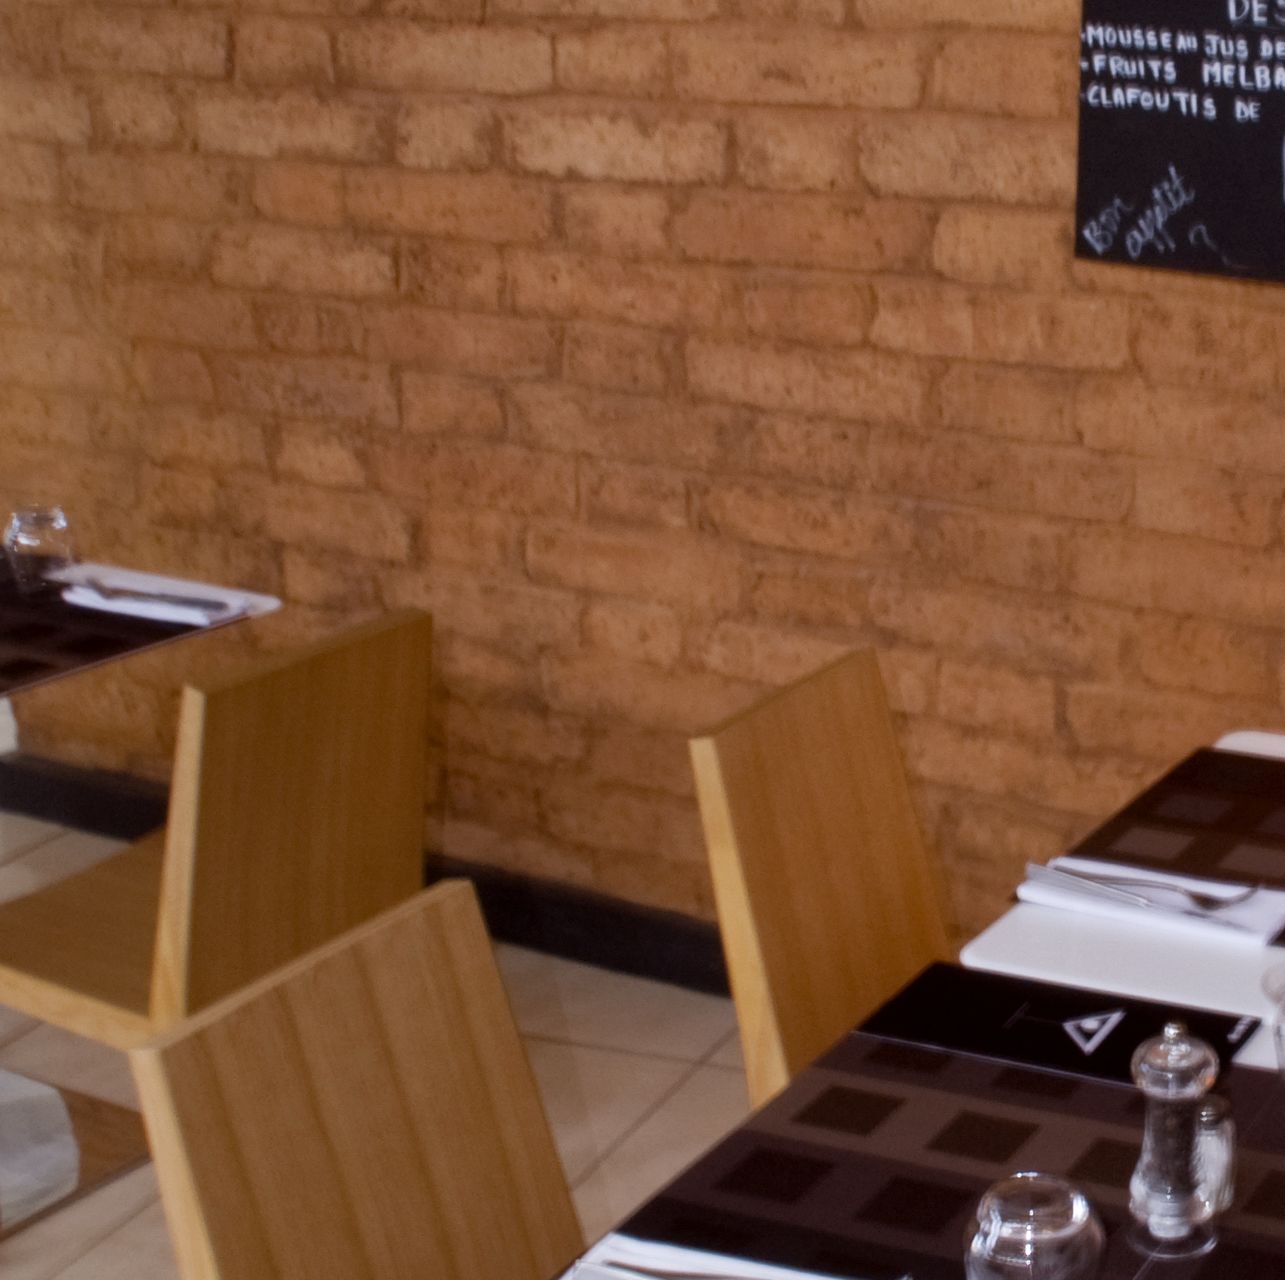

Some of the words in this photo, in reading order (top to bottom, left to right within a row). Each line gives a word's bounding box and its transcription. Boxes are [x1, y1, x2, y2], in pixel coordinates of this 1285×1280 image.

[1085, 23, 1172, 50] MOUSSE
[1203, 32, 1248, 60] JUS
[1092, 52, 1176, 84] FRUITS
[1086, 82, 1217, 120] CLAFOUTIS
[1234, 95, 1261, 122] DE
